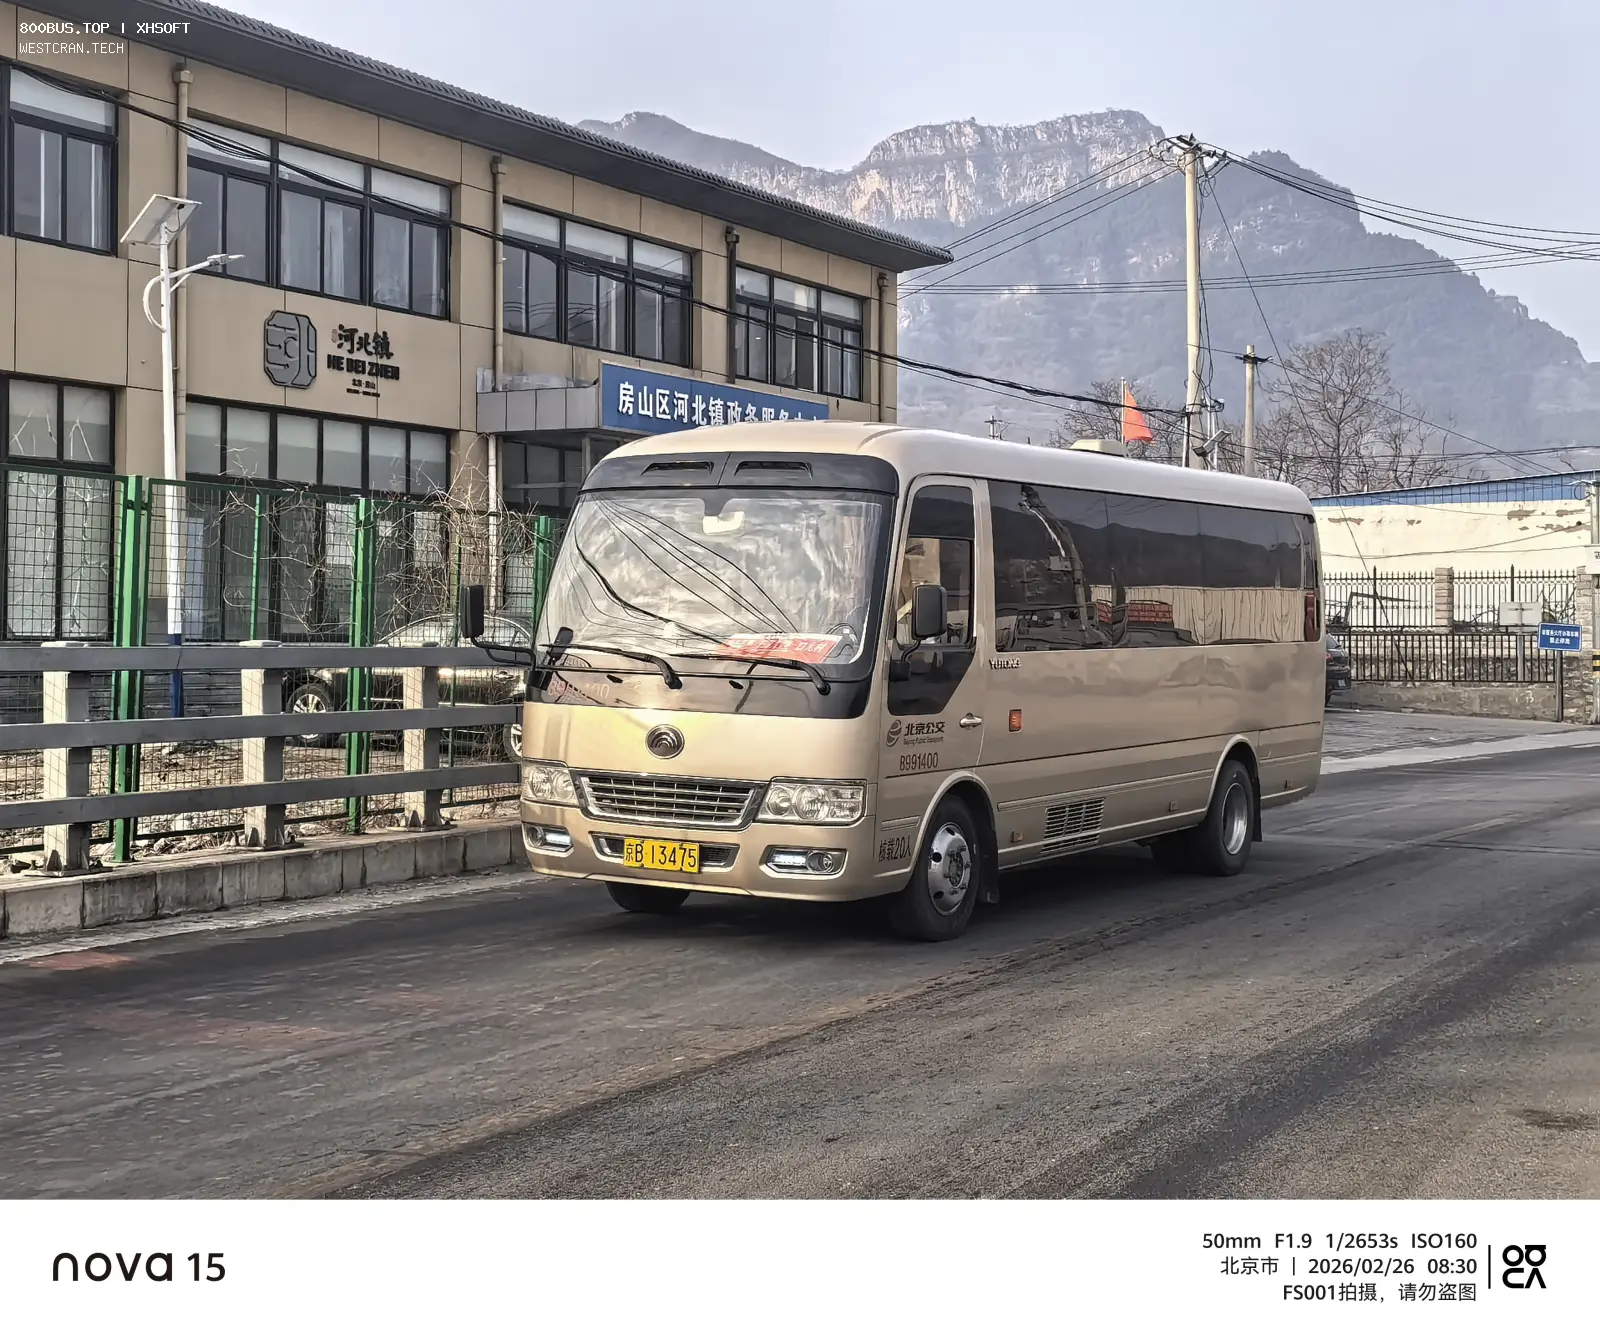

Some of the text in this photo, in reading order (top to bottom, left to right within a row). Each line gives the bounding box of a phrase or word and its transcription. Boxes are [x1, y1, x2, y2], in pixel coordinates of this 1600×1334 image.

[337, 324, 394, 360] 河北镇
[327, 354, 344, 371] HE
[618, 381, 818, 426] 房山区河北镇政务服
[904, 721, 946, 737] 北京公交
[900, 752, 939, 771] B991400
